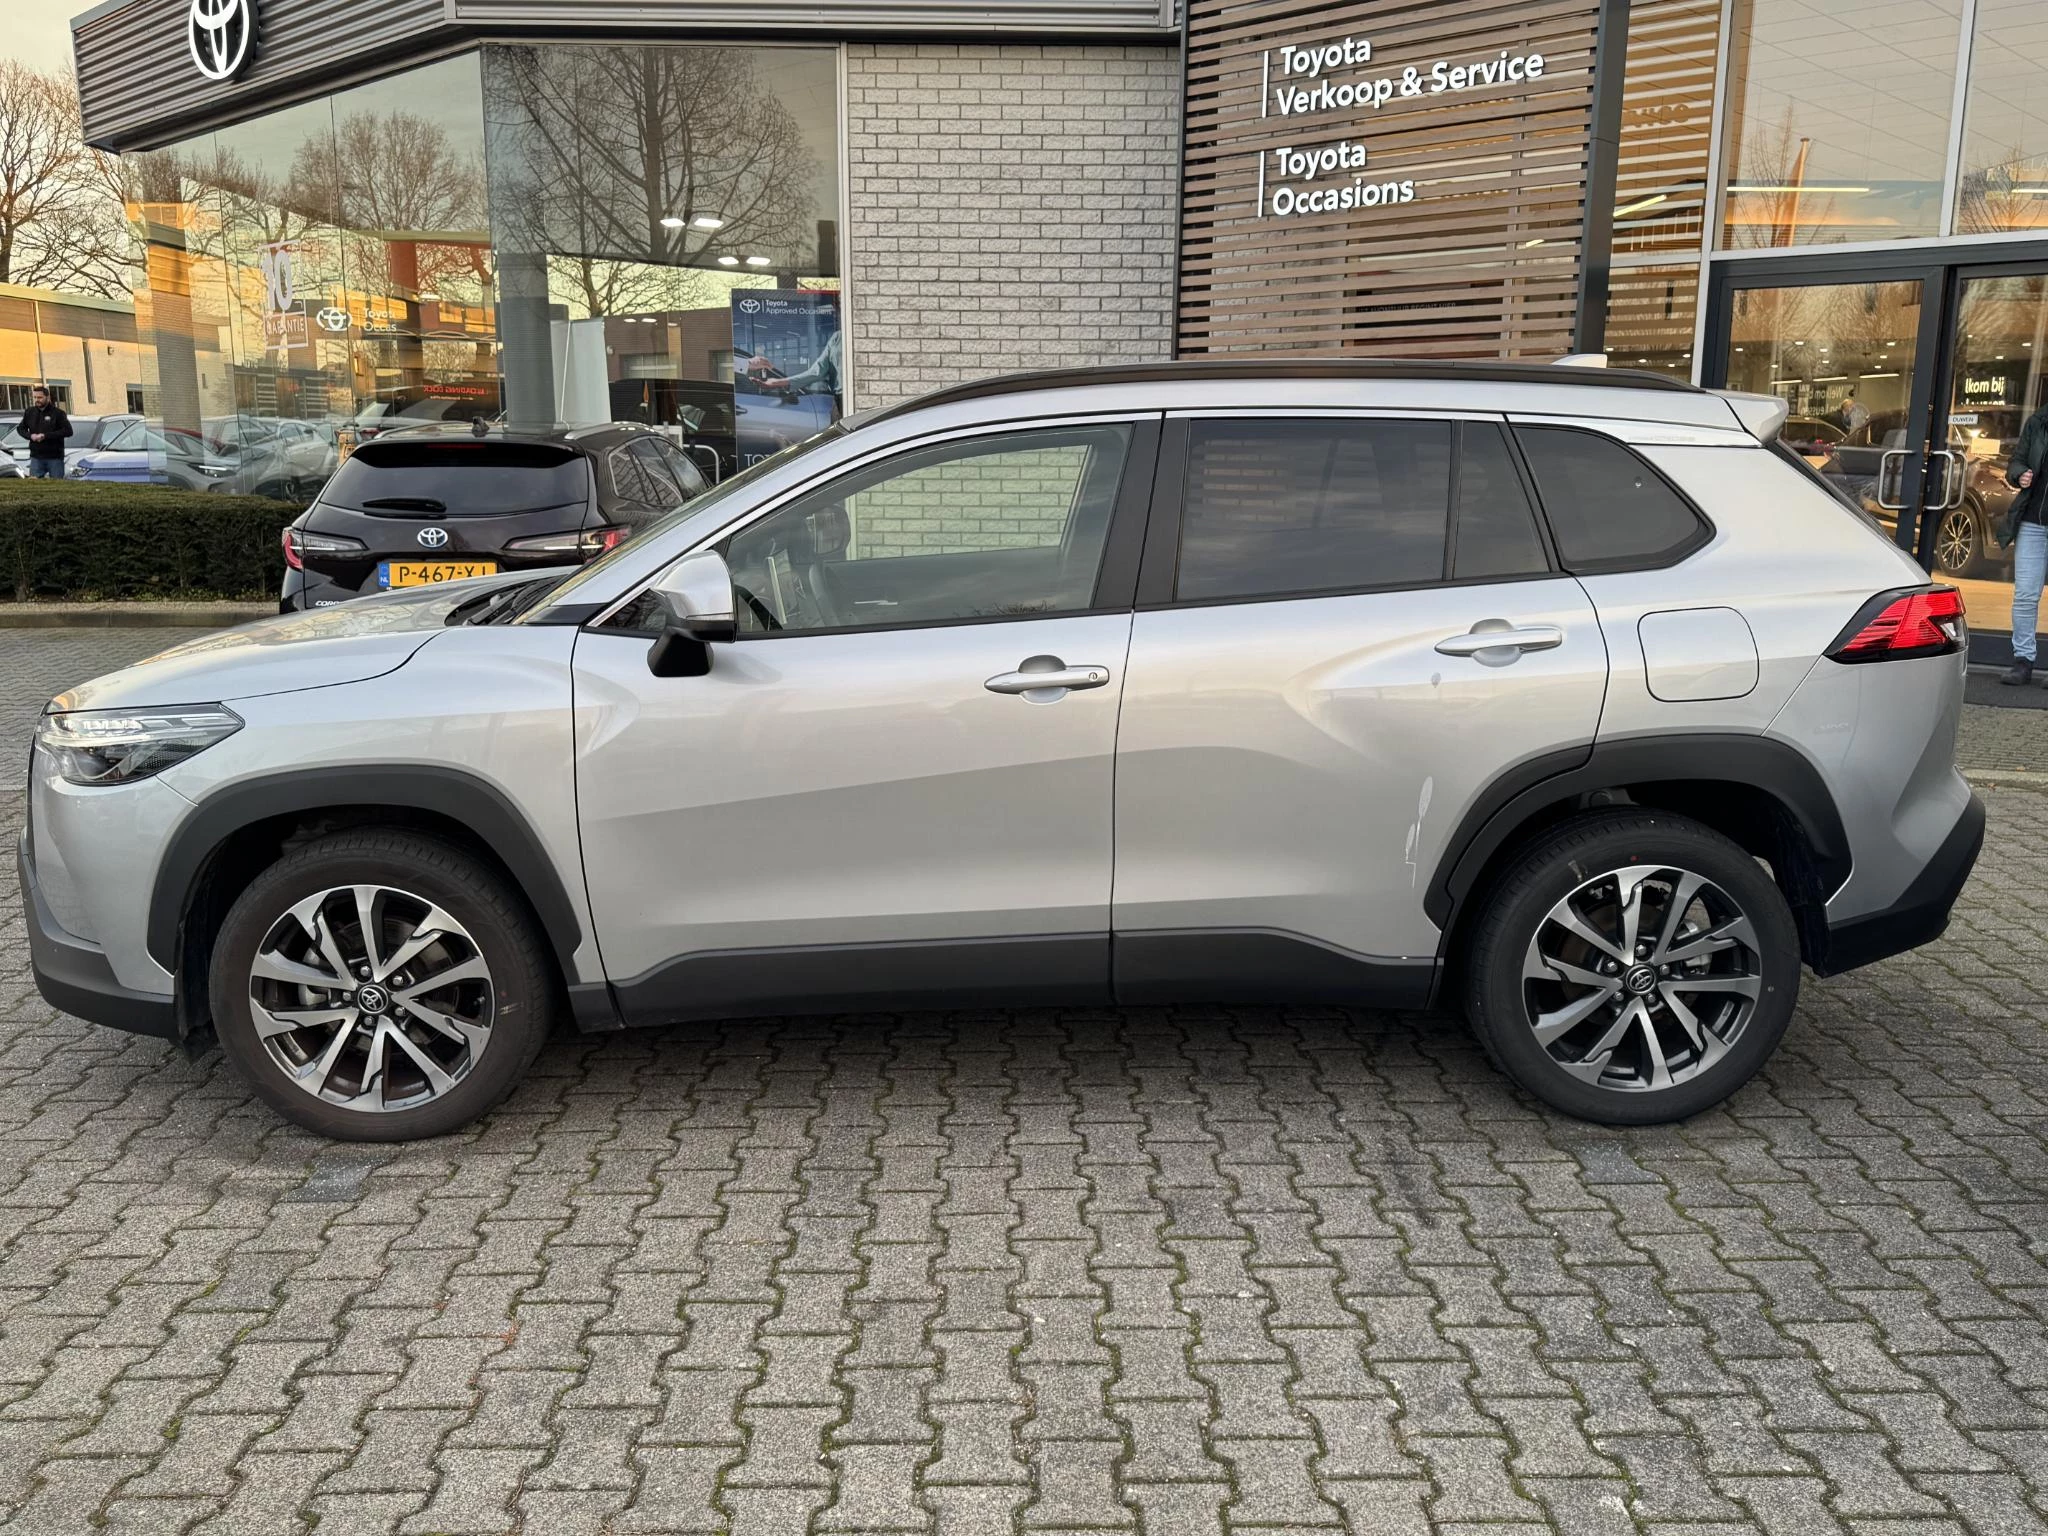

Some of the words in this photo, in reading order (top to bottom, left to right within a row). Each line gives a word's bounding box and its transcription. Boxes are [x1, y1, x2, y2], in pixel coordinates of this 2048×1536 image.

[1280, 37, 1371, 78] Toyota
[1276, 78, 1393, 115] Verkoop
[1400, 66, 1423, 96] &
[1430, 51, 1545, 92] Service
[1275, 141, 1367, 180] Toyota
[1272, 178, 1414, 216] Occasions
[765, 299, 788, 309] Toyota
[766, 307, 797, 315] Approved
[1991, 376, 2005, 396] bij
